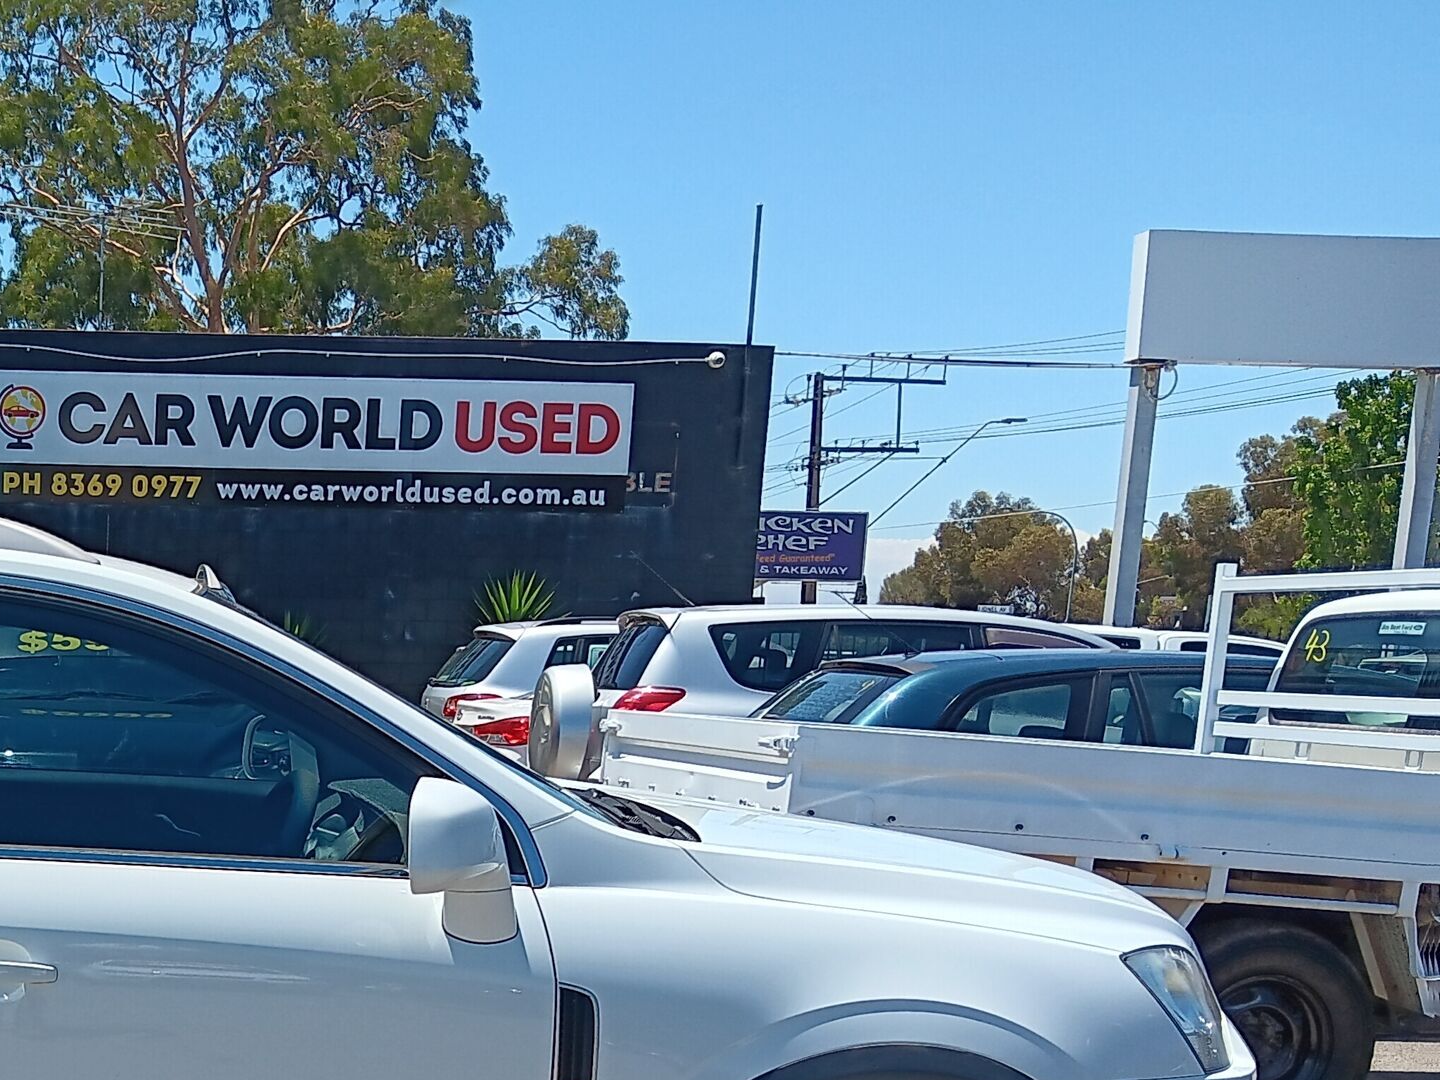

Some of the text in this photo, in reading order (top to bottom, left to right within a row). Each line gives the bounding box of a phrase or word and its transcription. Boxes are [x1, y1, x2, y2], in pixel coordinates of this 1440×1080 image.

[58, 391, 621, 456] CAR WORLD USED
[2, 471, 203, 499] PH 8369 0977
[216, 479, 606, 506] www.carworldused.com.au
[759, 565, 849, 576] & TAKEAWAY
